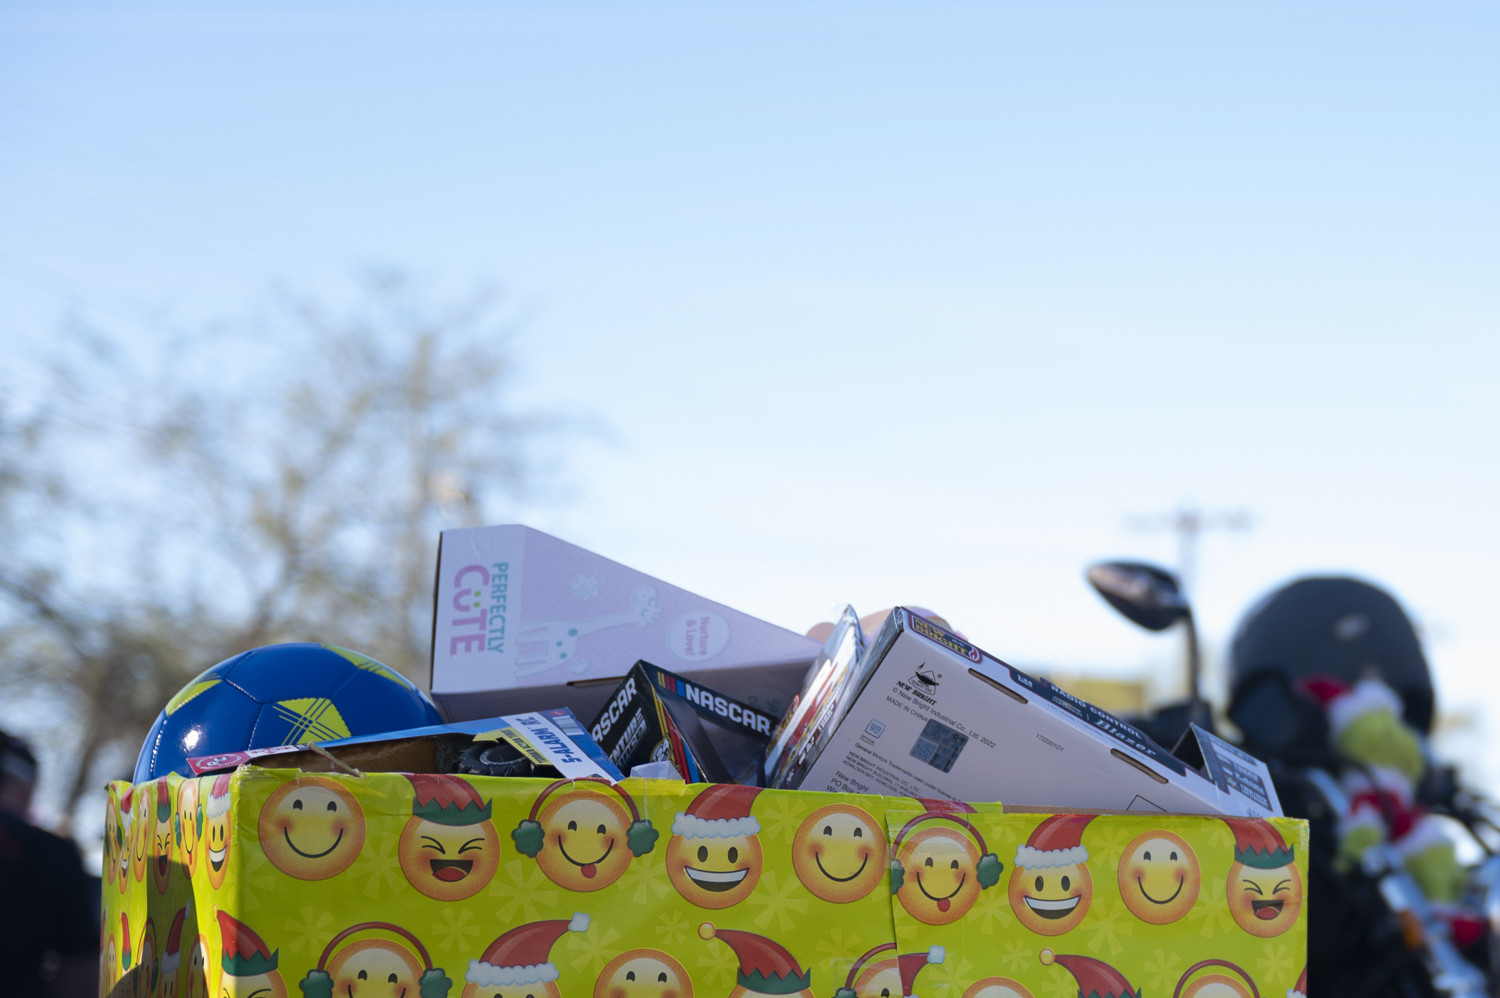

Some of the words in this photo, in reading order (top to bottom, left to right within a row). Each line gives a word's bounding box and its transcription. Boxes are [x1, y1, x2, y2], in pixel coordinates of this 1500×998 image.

[487, 562, 509, 654] PERFECTLY
[914, 617, 946, 638] NEW
[699, 615, 711, 656] Nurture
[591, 677, 638, 743] ASCAR
[685, 683, 772, 736] NASCAR
[886, 695, 903, 709] MADE
[903, 705, 910, 713] IN
[909, 709, 928, 722] CHINA
[896, 680, 912, 692] NEW
[911, 689, 938, 706] BRIGHT
[1050, 685, 1087, 708] RADIO
[1090, 707, 1142, 739] CONTROL
[899, 690, 912, 701] New
[912, 696, 931, 712] Bright
[930, 707, 957, 726] Industrial
[980, 736, 996, 748] 2022
[1095, 719, 1157, 756] Blazer
[831, 777, 842, 788] PO
[835, 770, 850, 783] New
[850, 777, 869, 792] Bright
